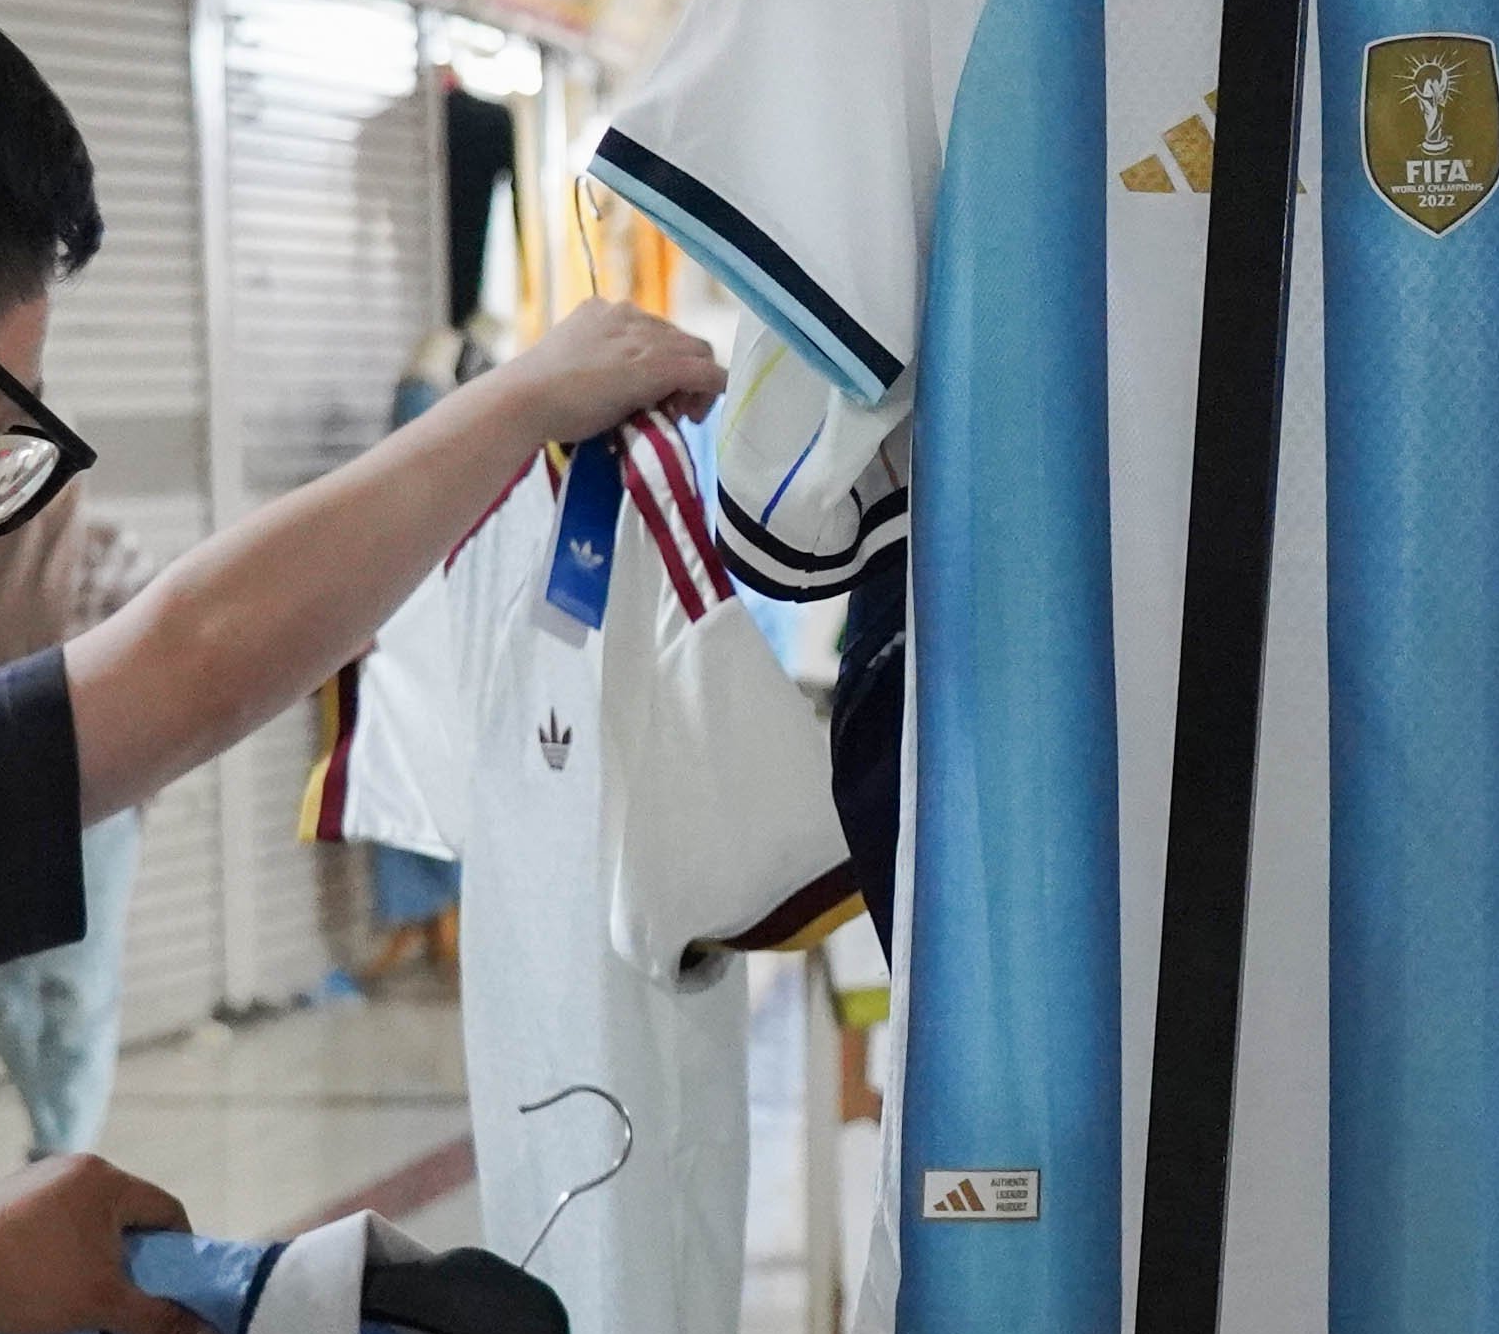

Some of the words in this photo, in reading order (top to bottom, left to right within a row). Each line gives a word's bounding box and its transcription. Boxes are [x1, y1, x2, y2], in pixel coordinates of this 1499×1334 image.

[1405, 159, 1470, 184] FIFA
[1391, 184, 1425, 194] WORLD
[1427, 182, 1485, 193] CHAMPIONS
[1418, 195, 1456, 208] 2022
